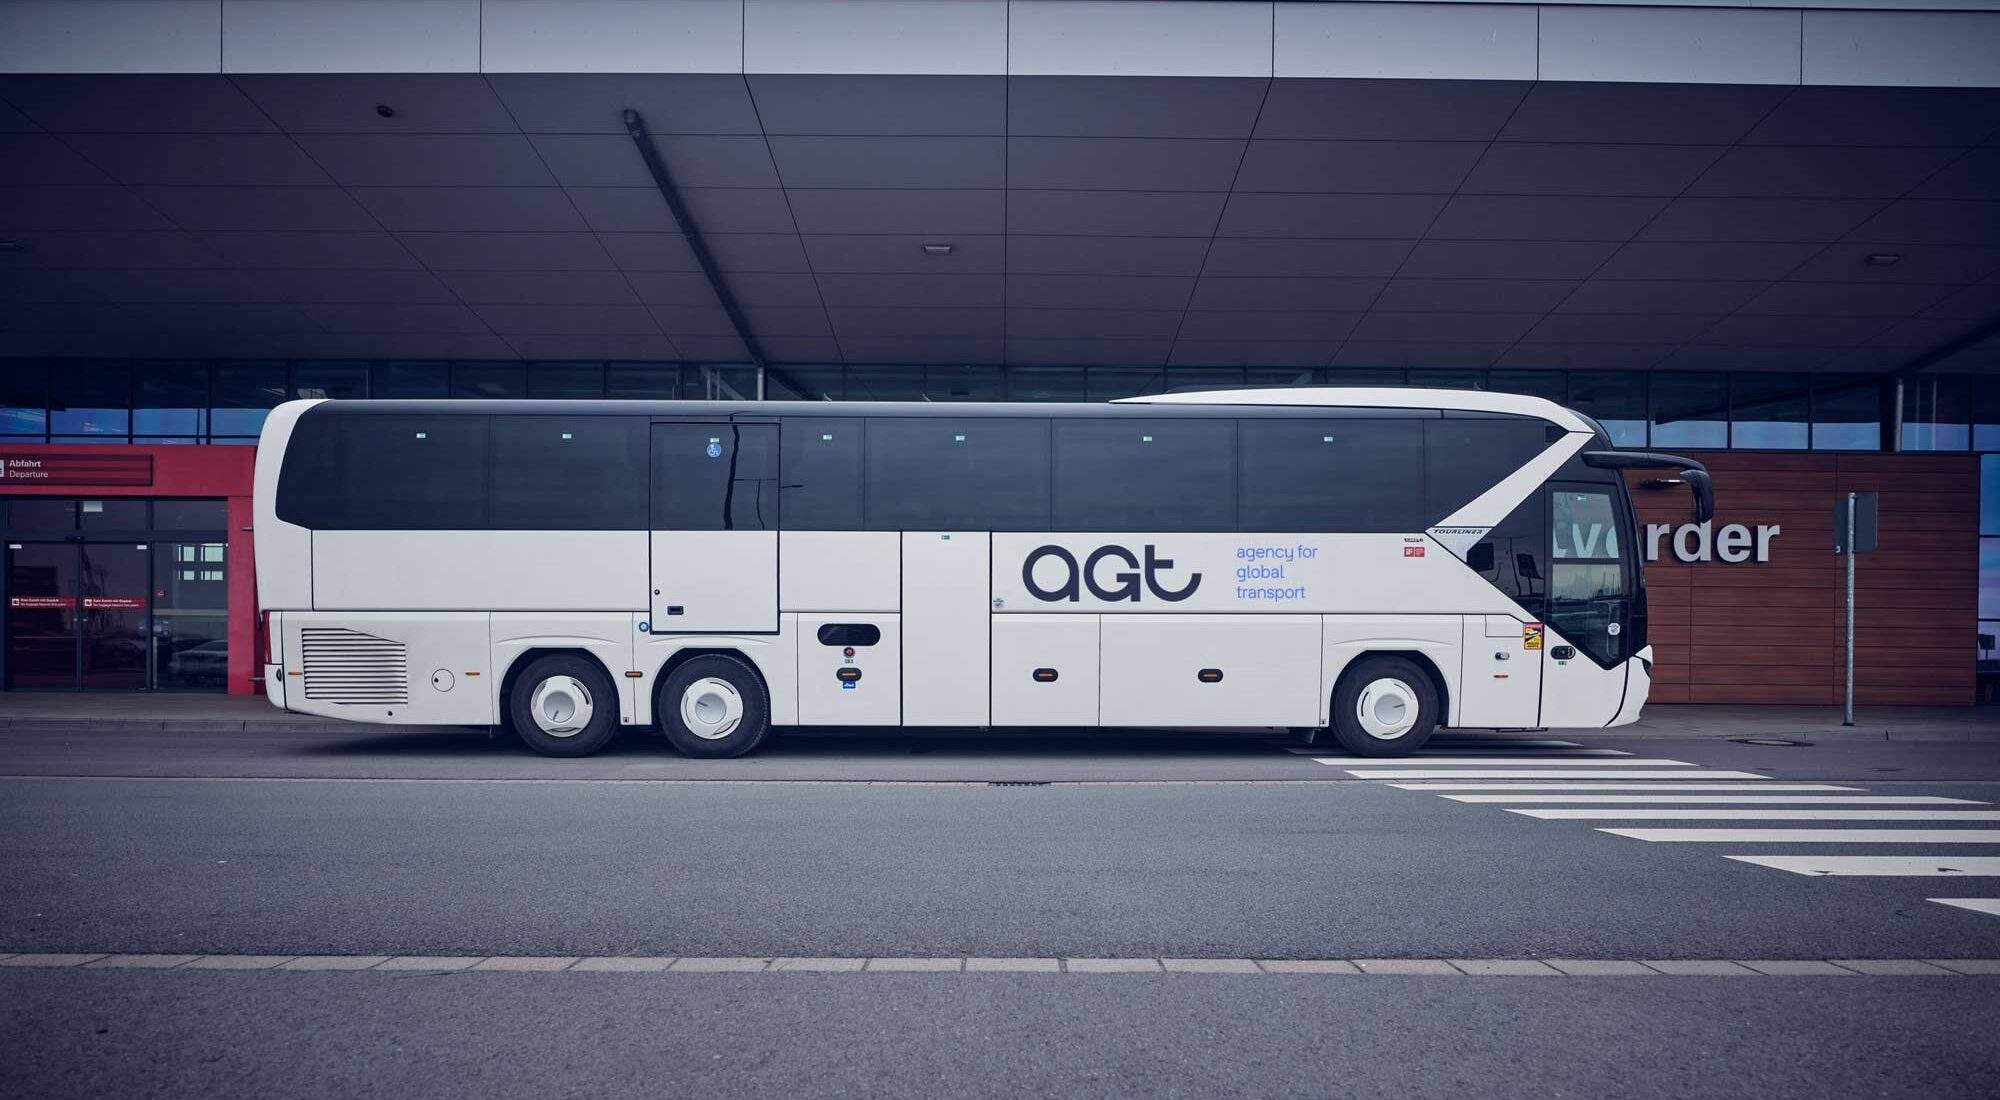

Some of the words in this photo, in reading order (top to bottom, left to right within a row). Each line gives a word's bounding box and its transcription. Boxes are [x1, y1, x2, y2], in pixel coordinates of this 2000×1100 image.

[9, 460, 41, 468] Abfahrt
[9, 470, 49, 479] Departure
[1236, 546, 1294, 562] agency
[1297, 546, 1318, 558] for
[1236, 565, 1285, 582] global
[1236, 585, 1305, 602] transport
